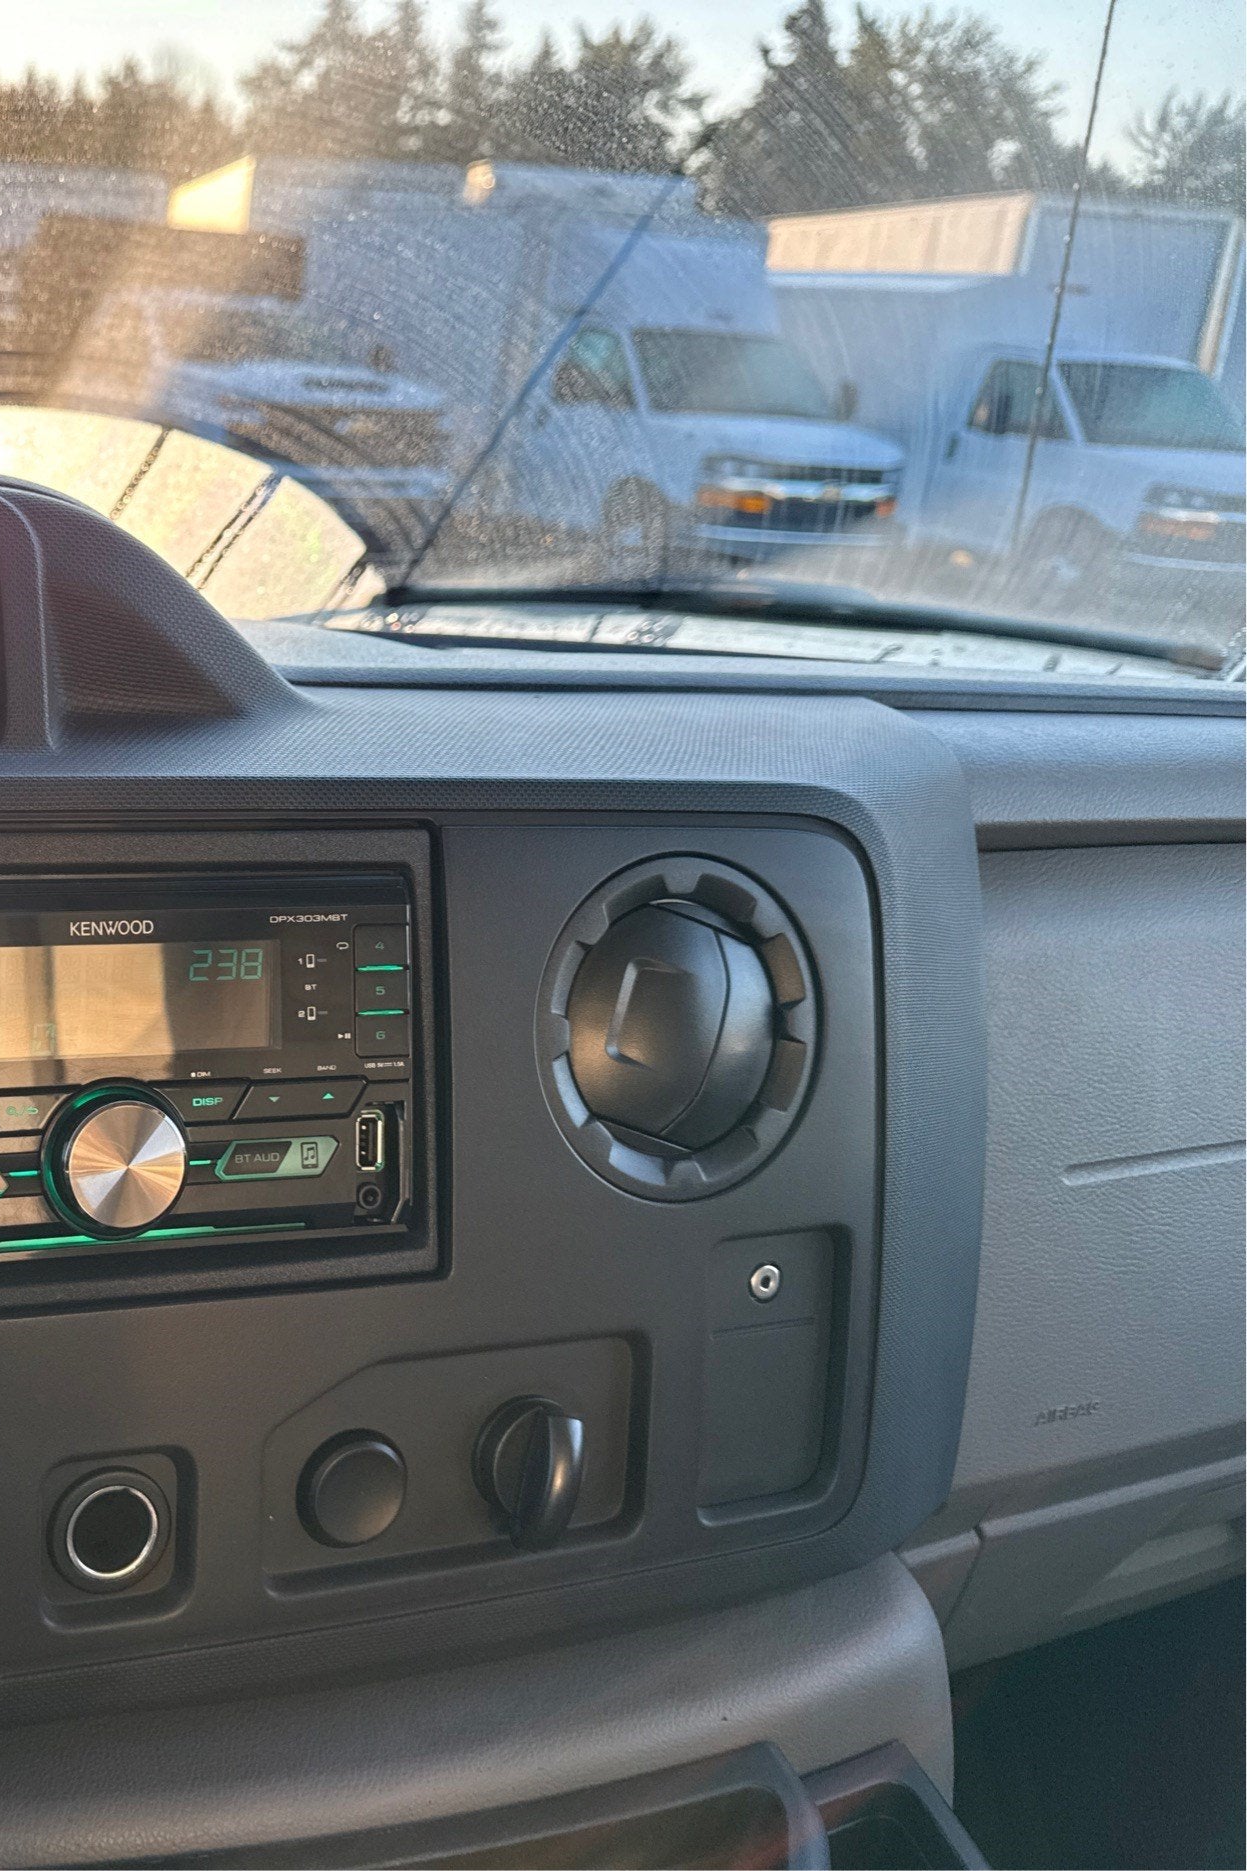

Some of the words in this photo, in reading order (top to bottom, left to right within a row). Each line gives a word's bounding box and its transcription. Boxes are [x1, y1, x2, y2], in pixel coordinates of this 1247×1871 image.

[269, 913, 348, 923] DPX303MBT
[69, 920, 154, 937] KENWOOD
[188, 948, 263, 981] 238
[376, 986, 386, 996] 5
[376, 1031, 386, 1040] 6
[192, 1097, 223, 1107] DISP
[235, 1154, 250, 1164] BT
[254, 1153, 280, 1163] AUD
